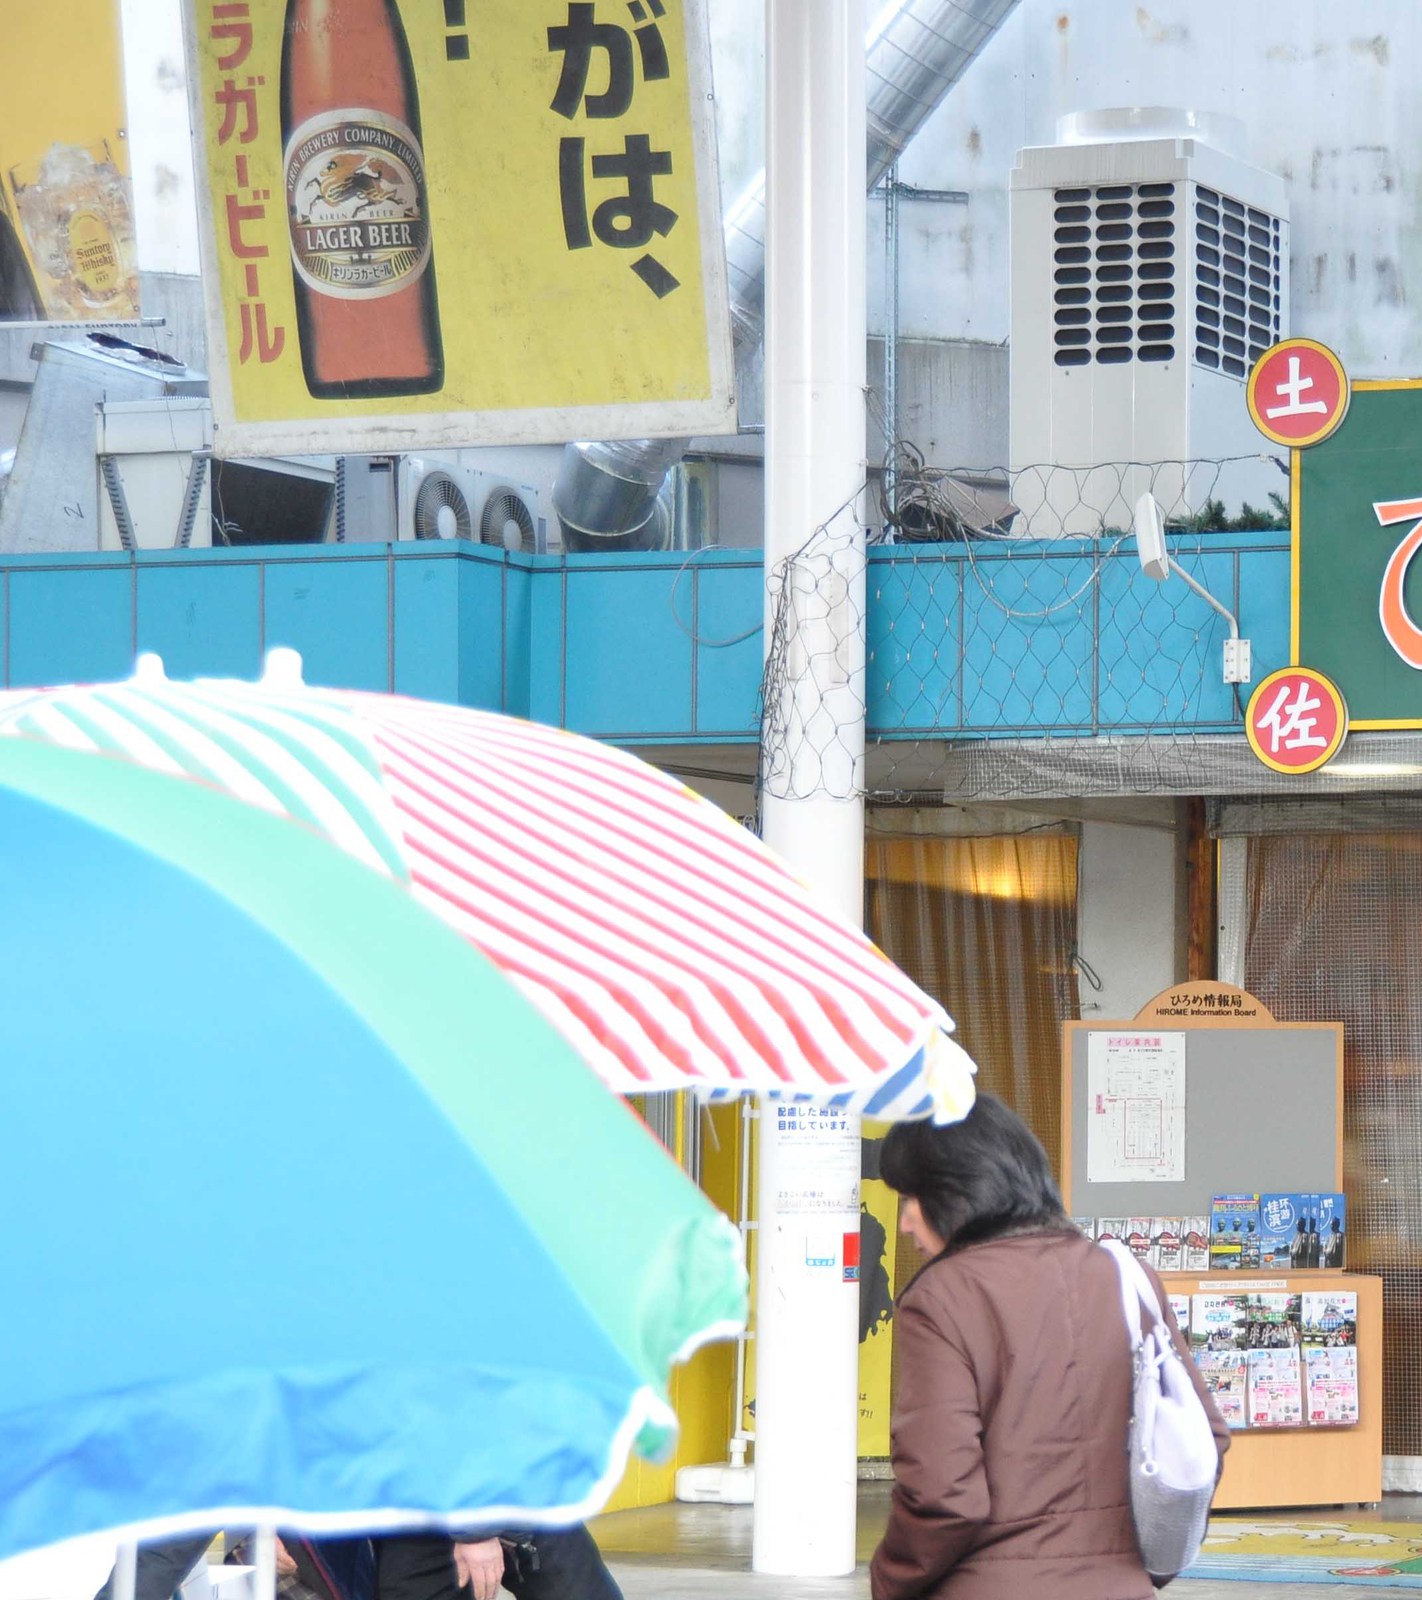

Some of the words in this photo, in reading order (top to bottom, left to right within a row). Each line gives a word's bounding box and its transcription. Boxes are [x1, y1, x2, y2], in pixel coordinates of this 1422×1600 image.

[211, 3, 286, 365] ラガービール
[300, 132, 342, 160] BREWERY
[398, 143, 423, 184] LIMITED
[306, 227, 364, 251] LAGER
[369, 223, 412, 246] BEER
[1266, 357, 1328, 419] 土
[1256, 682, 1328, 753] 佐
[1156, 1008, 1188, 1016] HIROME
[1190, 1008, 1232, 1016] Information
[1234, 1008, 1256, 1016] Board
[1170, 994, 1242, 1008] ひろめ情報局
